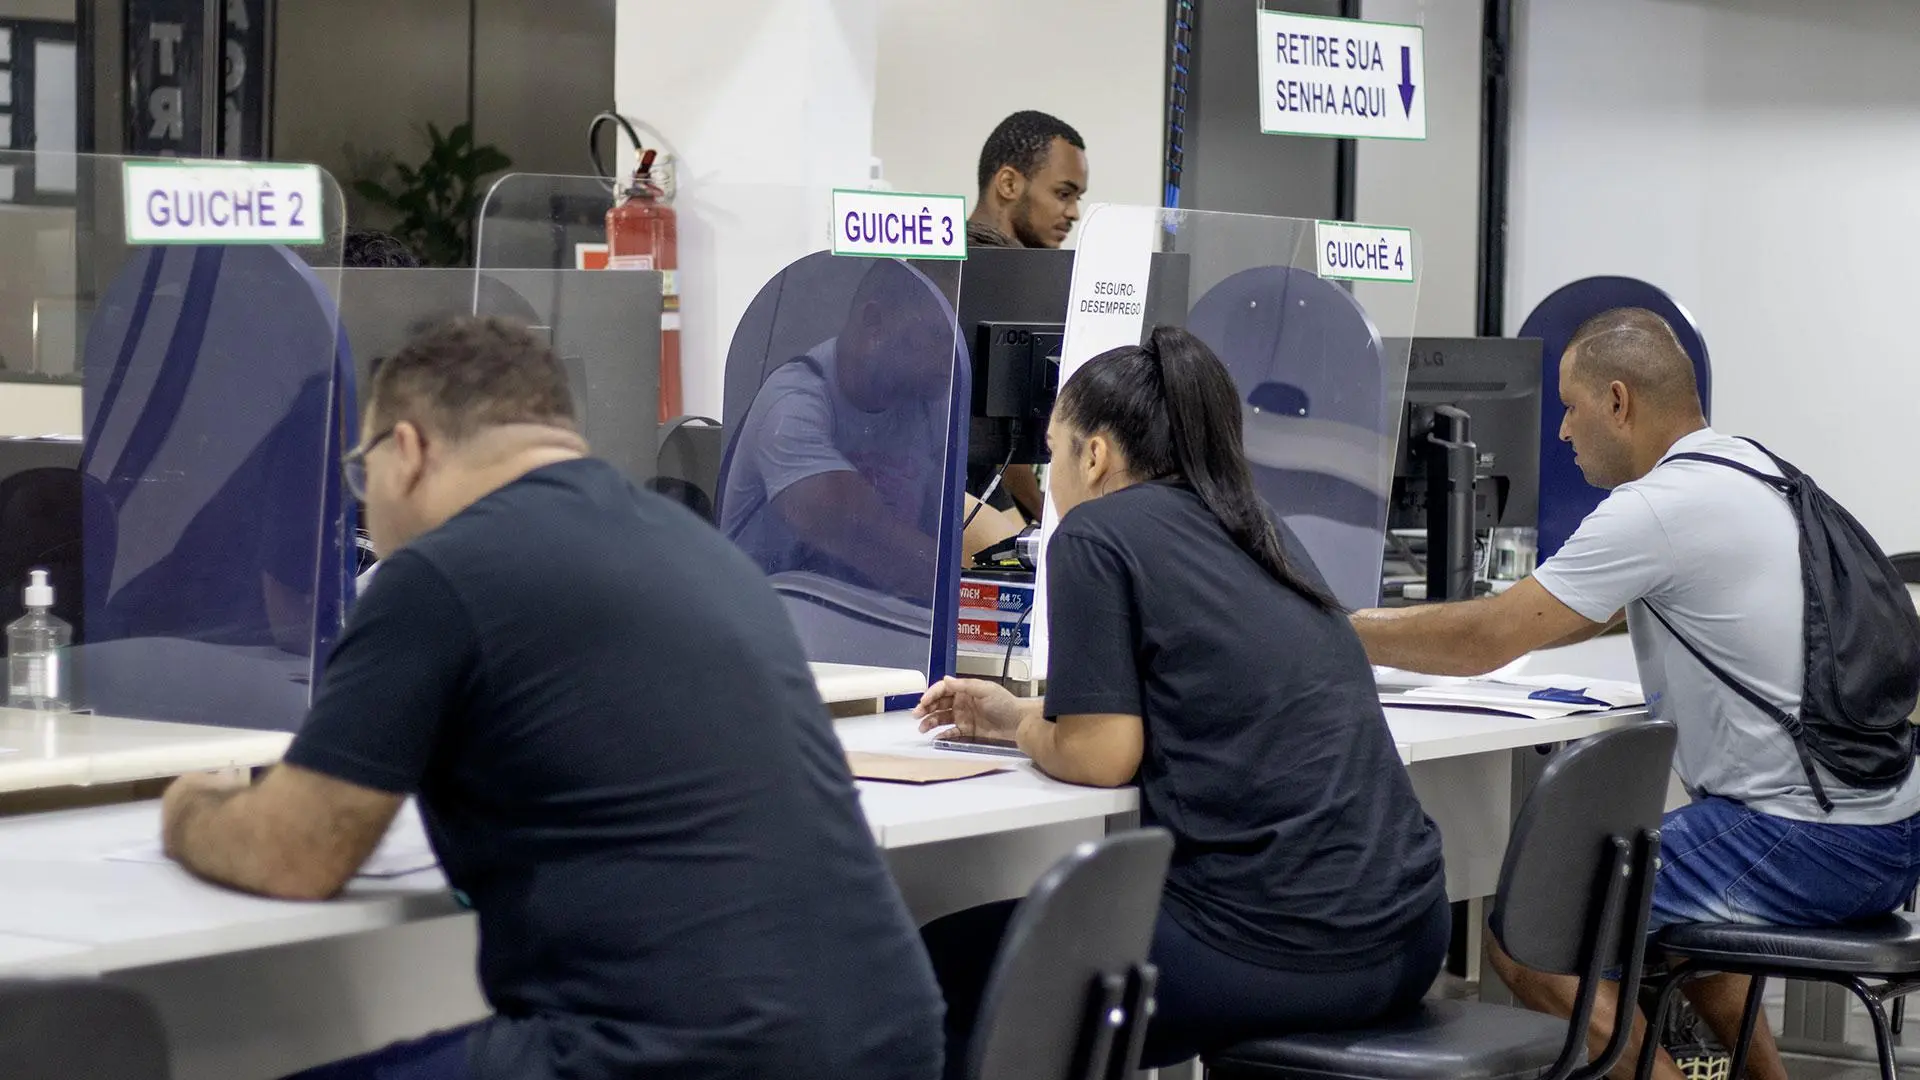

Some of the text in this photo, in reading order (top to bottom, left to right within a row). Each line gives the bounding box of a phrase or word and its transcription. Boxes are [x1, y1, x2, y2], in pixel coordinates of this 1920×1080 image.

[1276, 32, 1384, 71] RETIRE SUA
[1276, 79, 1386, 119] SENHA AQUI
[147, 180, 304, 227] GUICHÊ 2
[845, 206, 954, 246] GUICHÊ 3
[1326, 237, 1404, 271] GUICHÊ 4
[1094, 281, 1136, 297] SEGURO-
[1080, 299, 1142, 316] DESEMPREGO
[960, 588, 980, 599] MEX
[1000, 593, 1010, 602] A4
[1012, 594, 1021, 603] 75
[1001, 628, 1010, 637] A4
